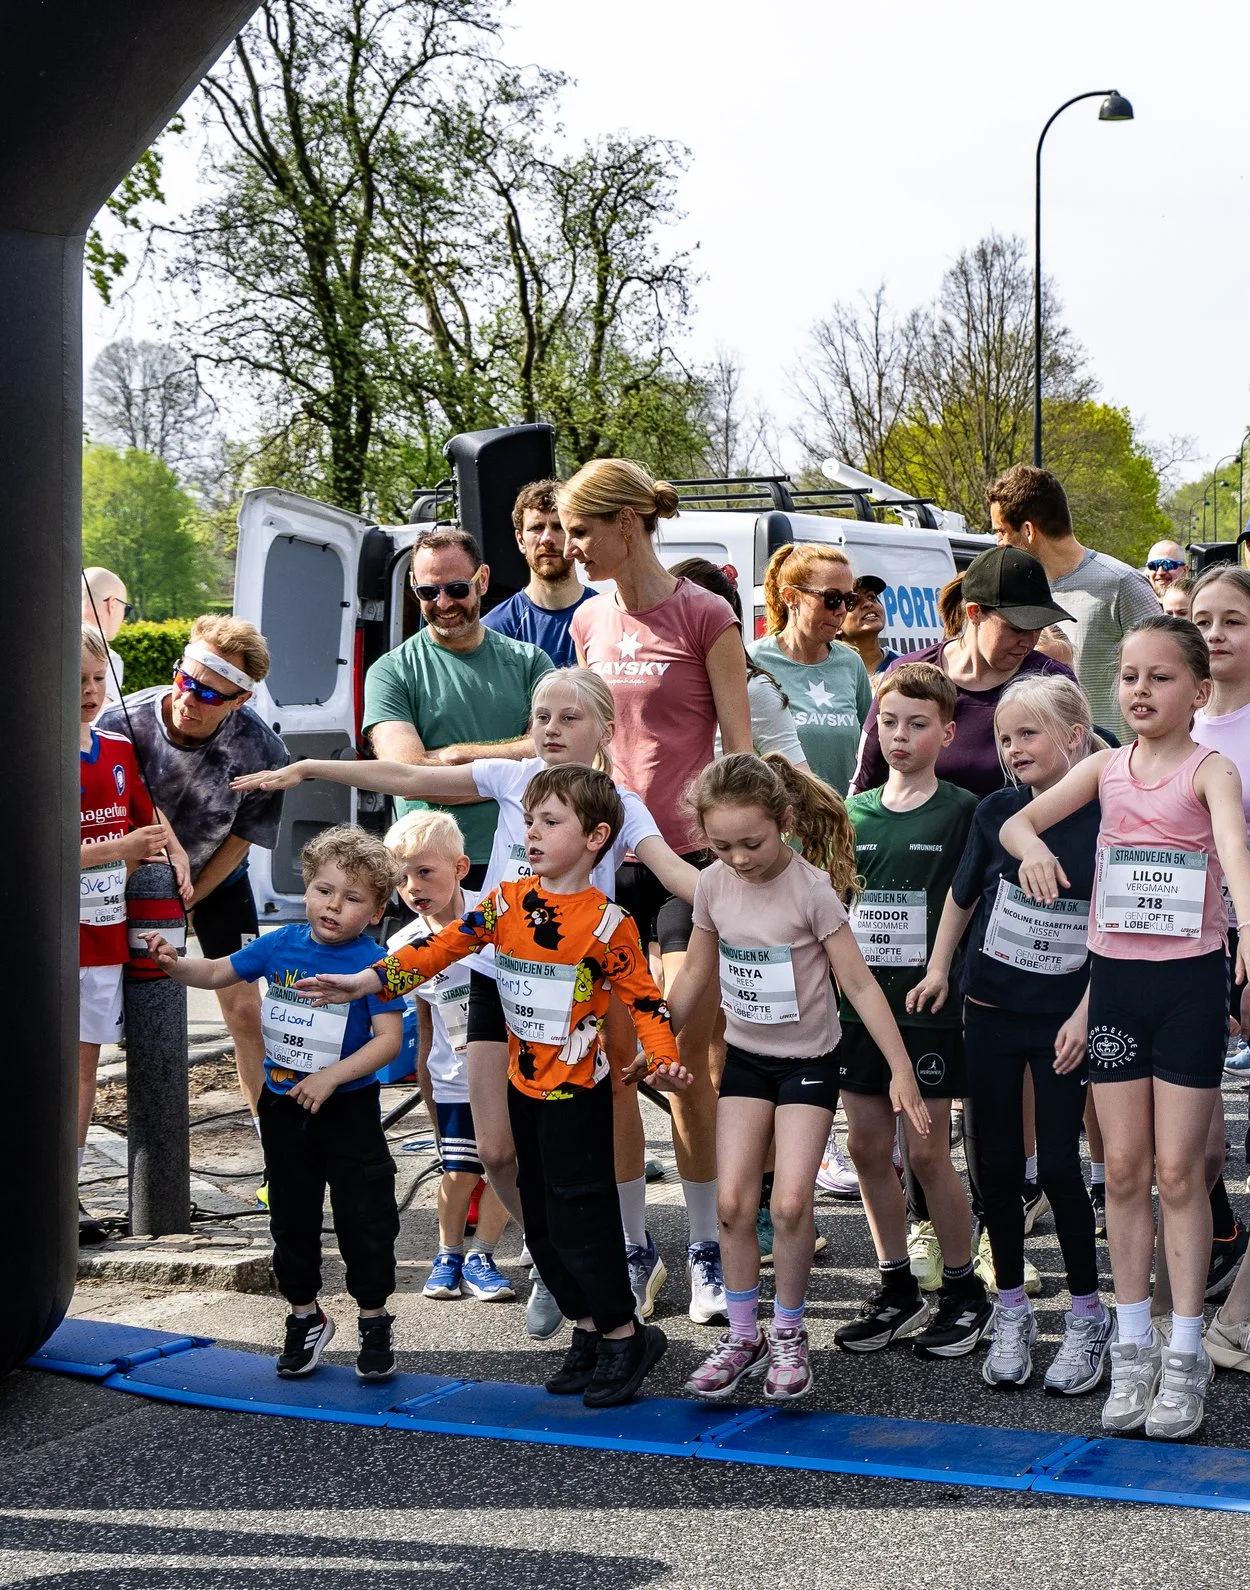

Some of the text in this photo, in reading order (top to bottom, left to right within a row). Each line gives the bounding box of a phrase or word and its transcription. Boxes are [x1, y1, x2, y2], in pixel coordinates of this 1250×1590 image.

[795, 711, 855, 727] SAYSKY
[909, 844, 943, 852] HVRUNNERS
[1115, 850, 1172, 864] STRANDVEJEN
[1173, 853, 1186, 865] 5K
[1133, 870, 1173, 883] LILOU
[1126, 882, 1179, 894] VERGMANN
[104, 895, 120, 906] 546
[897, 893, 908, 903] 5K
[1137, 897, 1163, 909] 218
[1067, 901, 1079, 912] 5K
[859, 910, 909, 920] THEODOR
[1003, 907, 1033, 925] NICOLINE
[1034, 920, 1072, 930] ELISABETH
[1125, 911, 1174, 922] GENTOFTE
[858, 921, 909, 930] DAM SOMMER
[1124, 920, 1174, 932] LØBEKLUB
[1028, 926, 1060, 938] NISSEN
[870, 934, 890, 943] 460
[861, 947, 902, 955] GENTOFTE
[1033, 939, 1049, 951] 83
[758, 950, 770, 961] 5K
[865, 955, 903, 963] ØBEKLUB
[1016, 948, 1062, 964] GENTOFTE
[499, 955, 556, 976] STRANDVEJEN 5K
[1014, 956, 1062, 972] LØBEKLUB
[729, 965, 762, 979] FREYA
[736, 977, 755, 987] REES
[737, 990, 758, 1002] 452
[515, 1004, 534, 1018] 589
[733, 999, 771, 1013] GENTOFTE
[734, 1006, 773, 1020] LØBEKLUB
[282, 1033, 304, 1048] 588
[273, 1044, 314, 1061] GENTOFTE
[274, 1052, 313, 1069] LØBEKLUB
